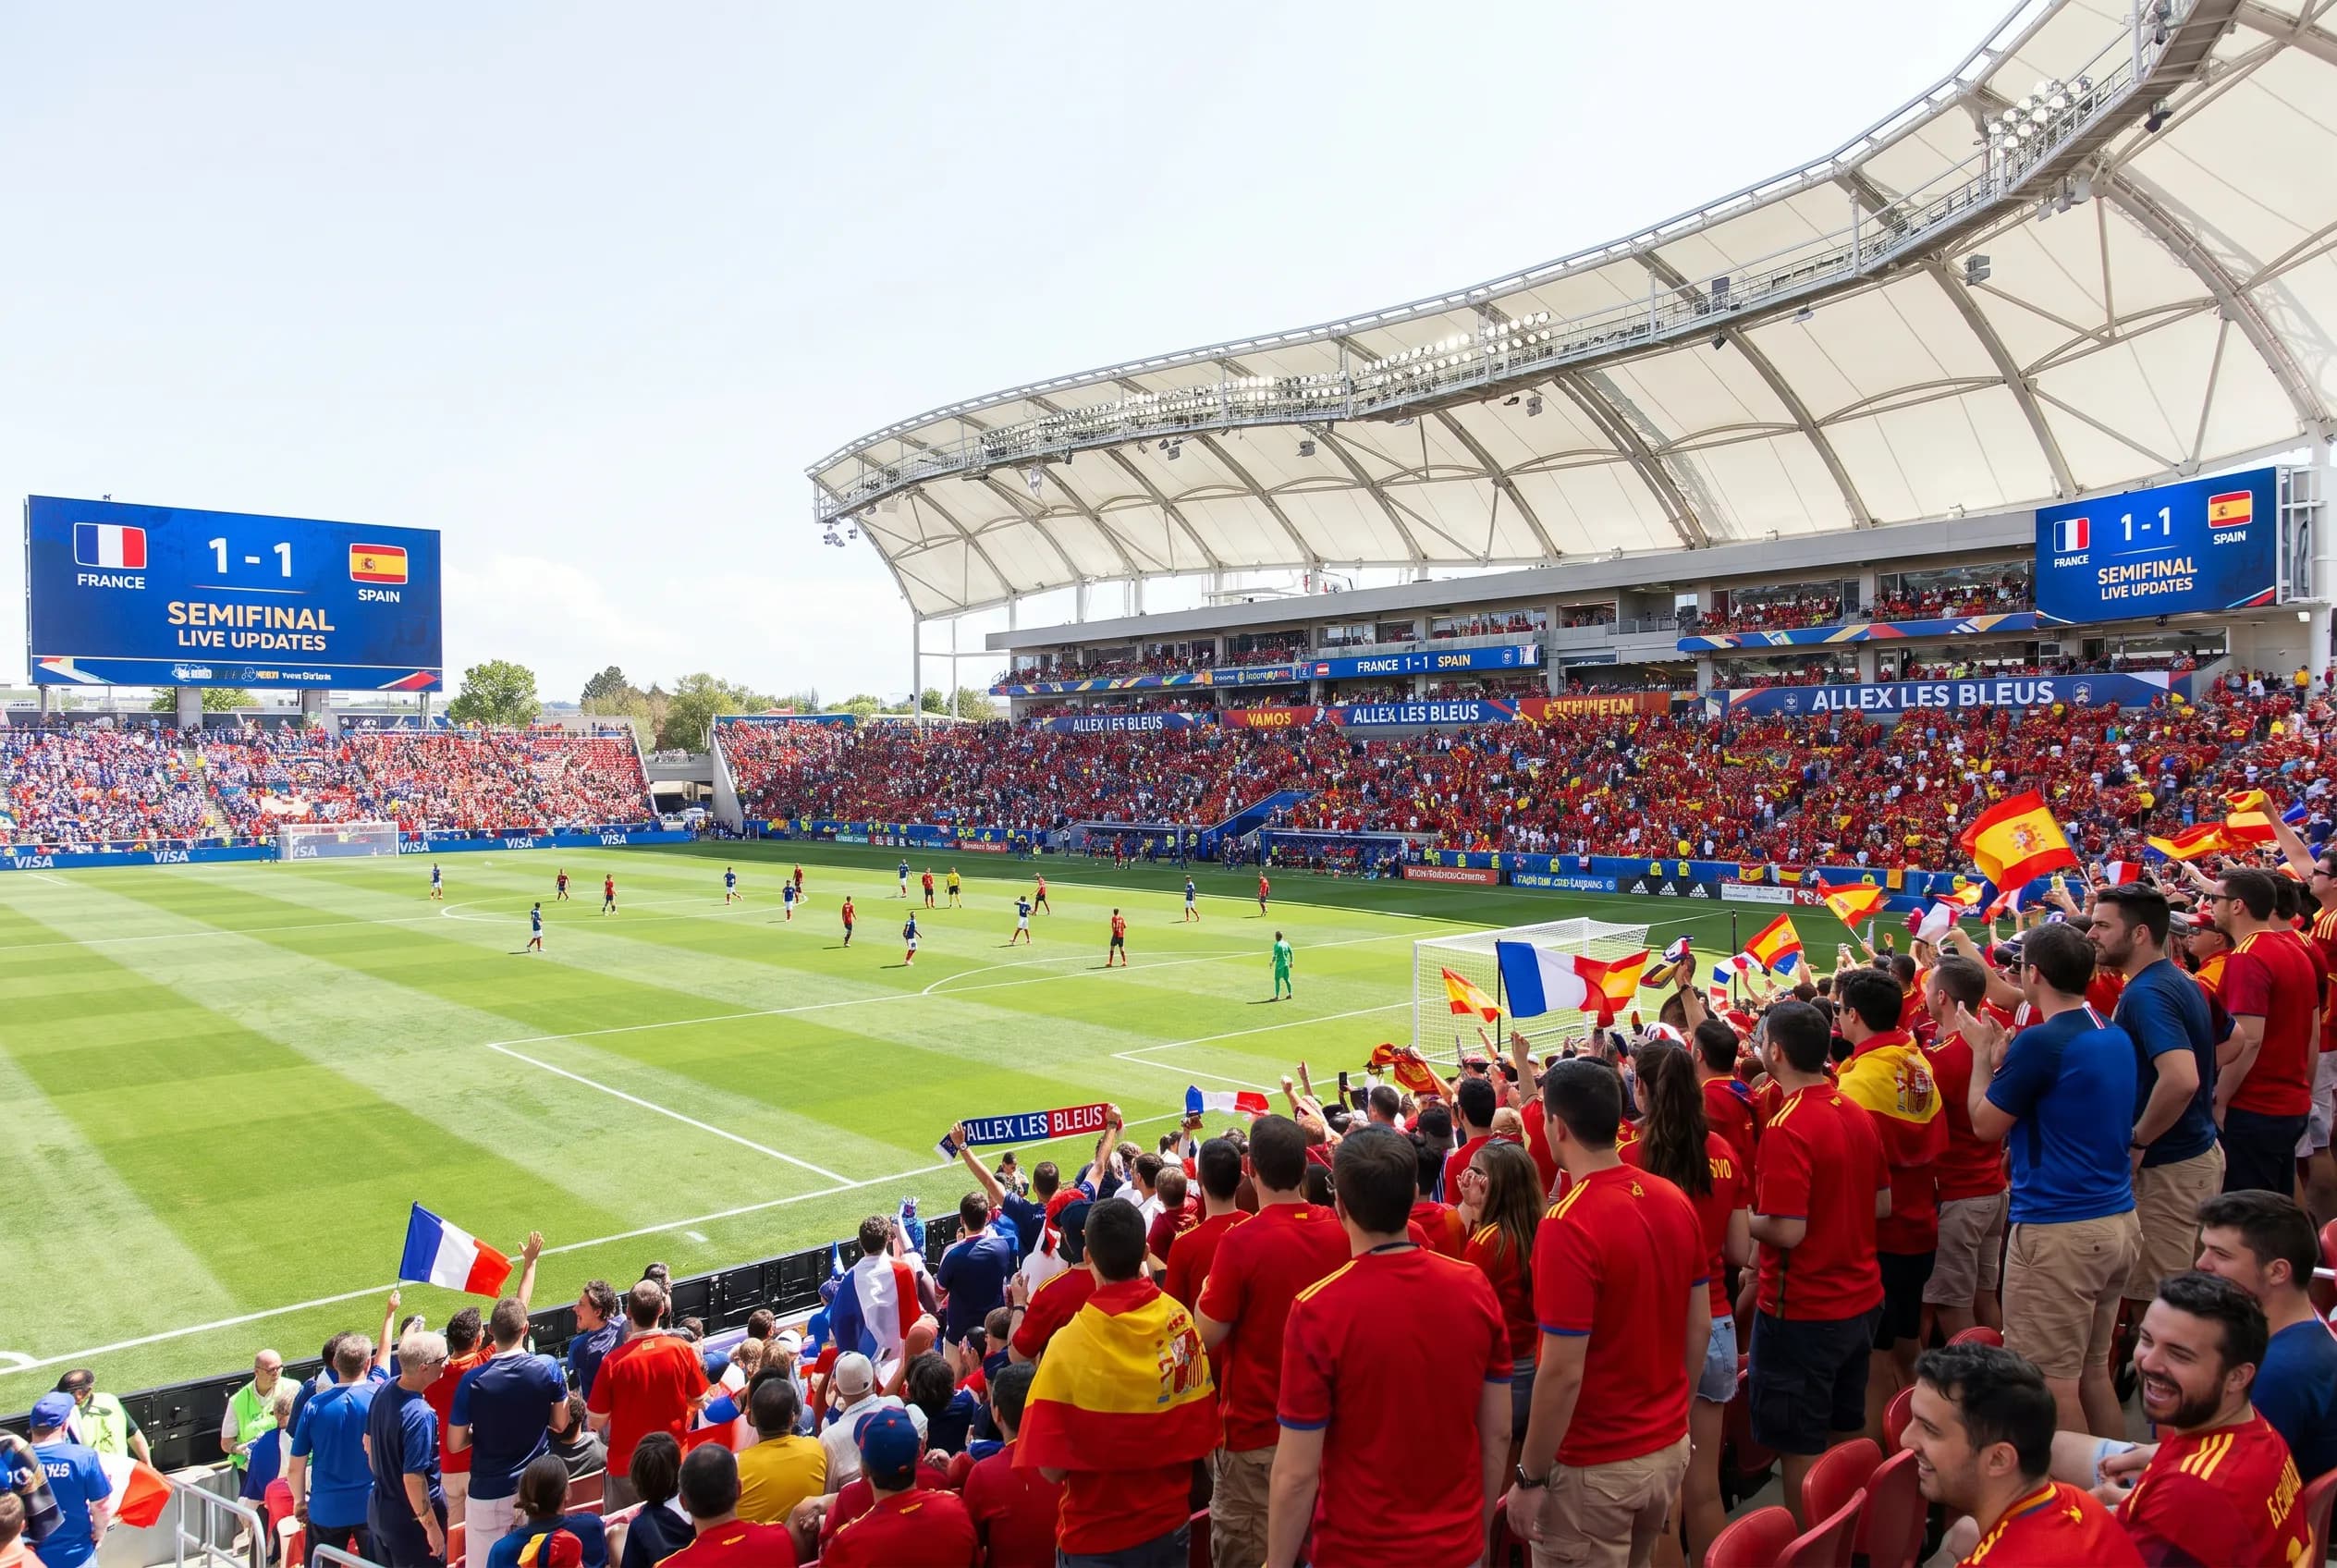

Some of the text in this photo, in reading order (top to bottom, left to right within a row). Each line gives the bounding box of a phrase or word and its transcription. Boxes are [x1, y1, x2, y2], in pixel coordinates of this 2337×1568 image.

[2121, 513, 2132, 541] 1
[2159, 507, 2171, 535] 1
[2213, 530, 2246, 545] SPAIN
[208, 537, 227, 573] 1
[274, 542, 291, 577] 1
[2054, 555, 2089, 569] FRANCE
[2098, 557, 2198, 585] SEMIFINAL
[77, 573, 146, 590] FRANCE
[2101, 577, 2194, 600] LIVE UPDATES
[358, 589, 400, 603] SPAIN
[167, 601, 335, 631] SEMIFINAL
[178, 630, 326, 651] LIVE UPDATES
[1357, 659, 1399, 673] FRANCE
[1405, 656, 1411, 670] 1
[1424, 655, 1428, 669] 1
[1438, 655, 1471, 668] SPAIN
[1812, 687, 1894, 711] ALLEX
[1901, 685, 1950, 707] LES
[1958, 681, 2054, 706] BLEUS
[1247, 712, 1291, 727] VAMOS
[1353, 704, 1479, 724] ALLEX LES BLEUS
[1073, 718, 1104, 732] ALLEX
[1128, 716, 1163, 730] BLEUS
[399, 841, 430, 853] VISA
[505, 837, 533, 850] VISA
[600, 833, 628, 846] VISA
[13, 855, 55, 869] VISA
[152, 851, 190, 864] VISA
[967, 1107, 1103, 1141] ALLEX LES BLEUS
